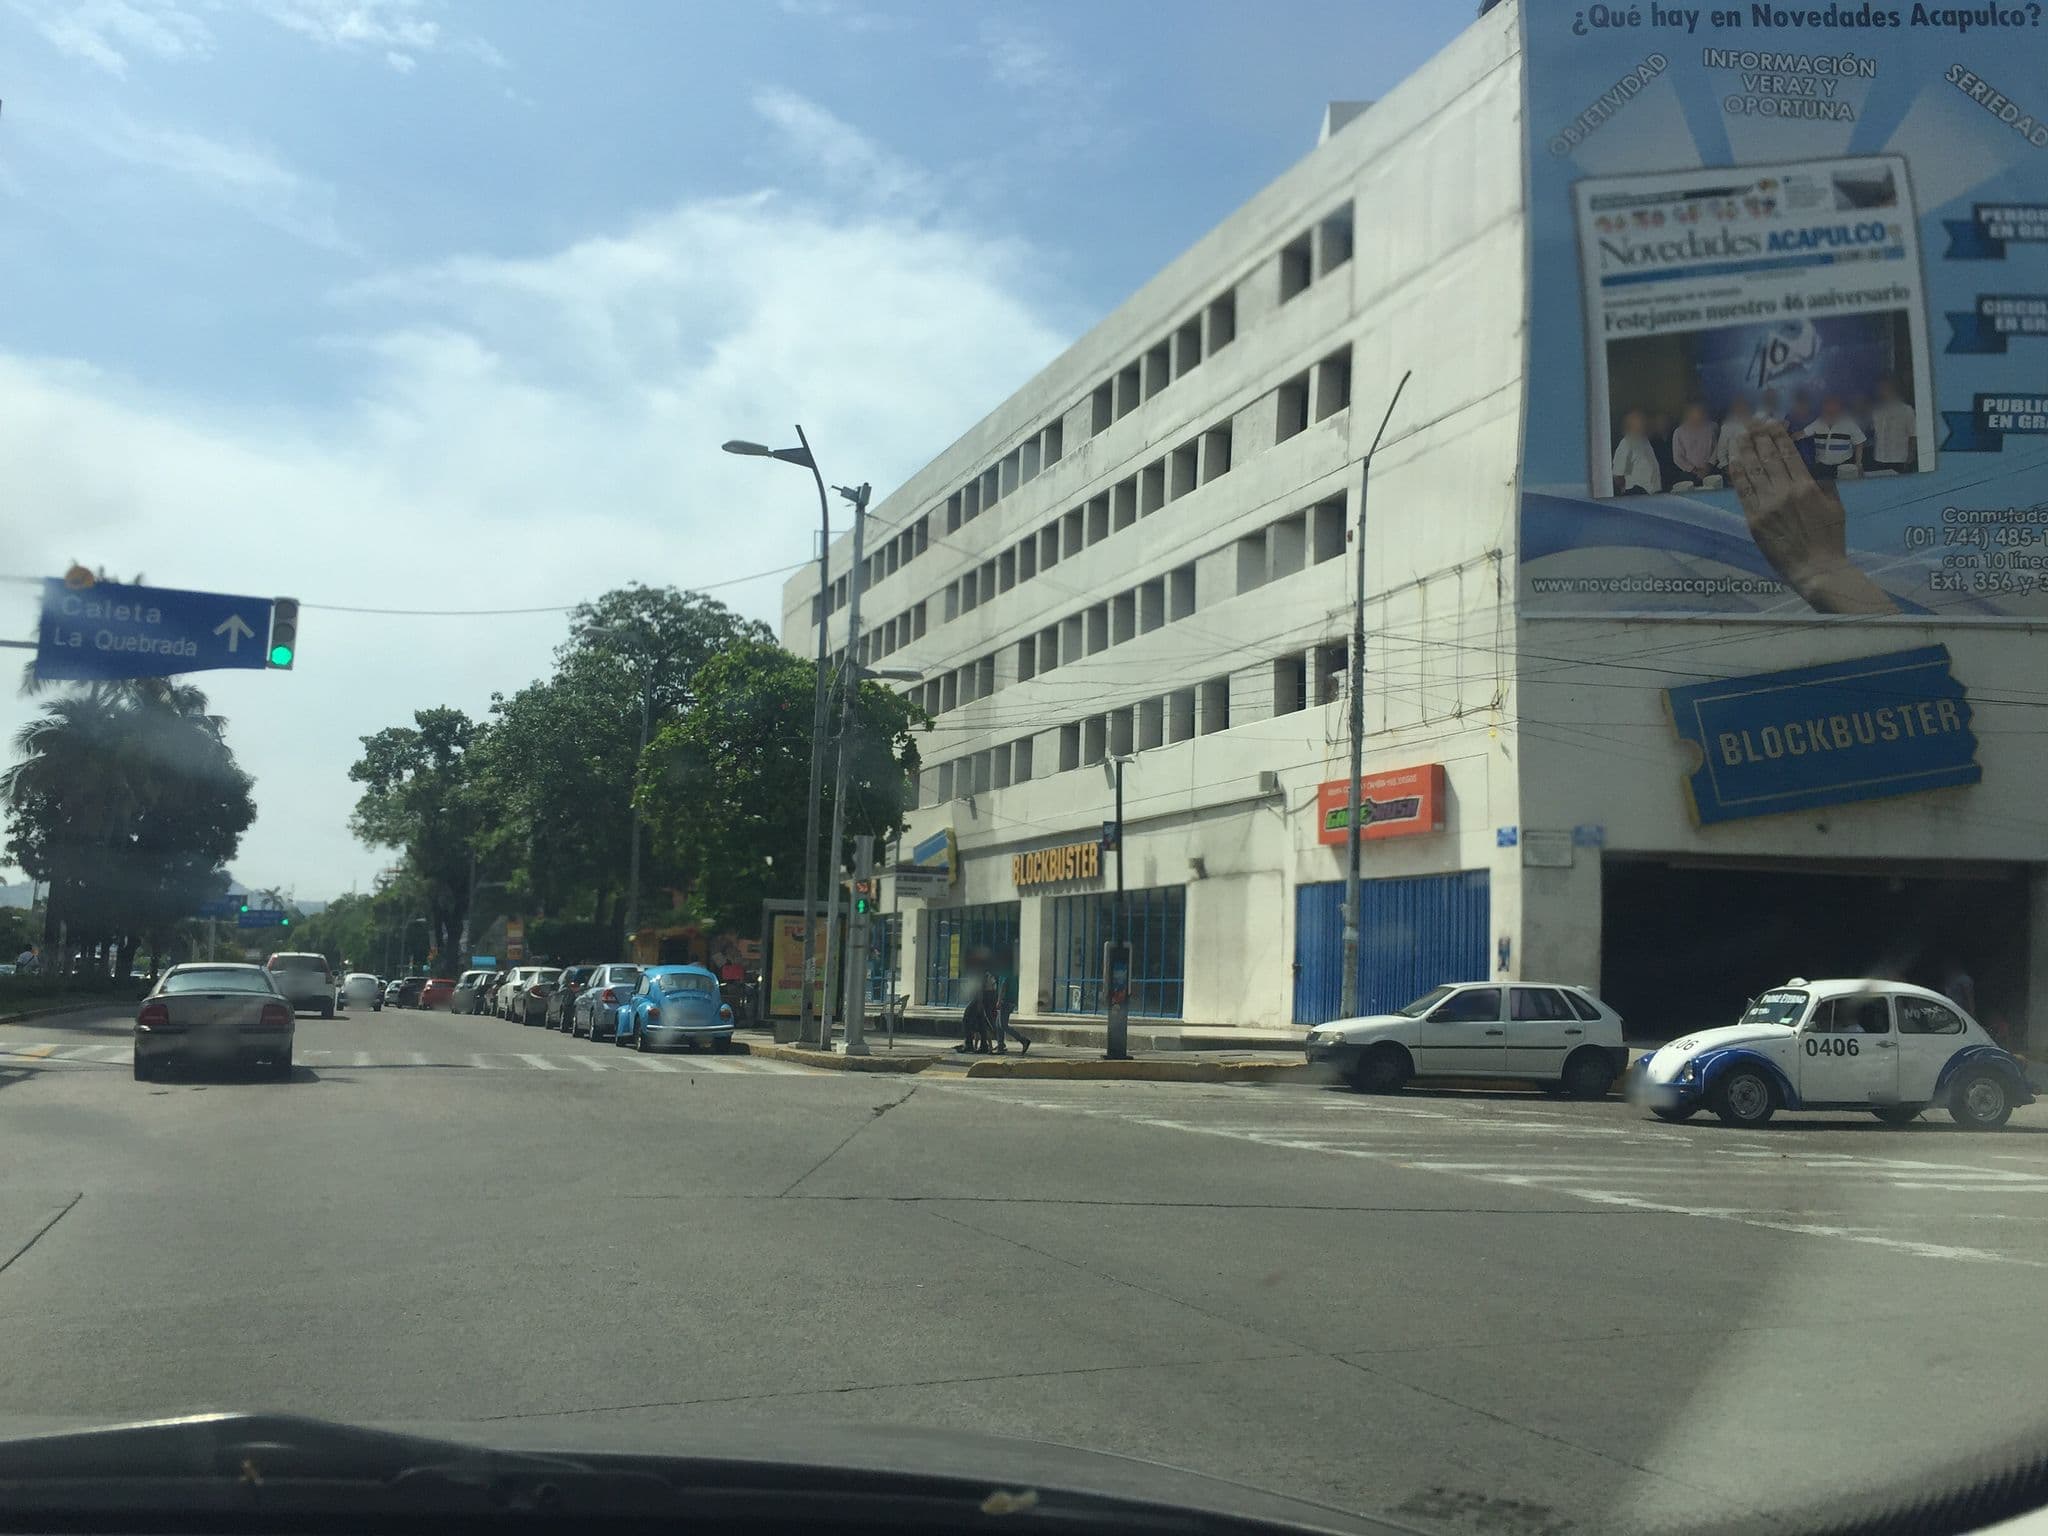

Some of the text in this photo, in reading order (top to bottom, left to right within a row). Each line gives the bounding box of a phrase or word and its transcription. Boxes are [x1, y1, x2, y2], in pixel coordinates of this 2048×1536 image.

[1572, 0, 2042, 36] ¿Qué hay en Novedades Acapulco?
[1703, 48, 1876, 77] INFORMACIÓN
[1742, 73, 1838, 97] VERAZ Y
[1549, 52, 1669, 157] OBJETIVIDAD
[1724, 95, 1855, 121] OPORTUNA
[1944, 63, 2048, 148] SERIEDAD
[1599, 220, 1886, 269] Novedades ACAPULCO
[1808, 281, 1911, 307] aniversario
[1988, 414, 2013, 428] EN
[1904, 526, 1936, 551] (01
[1943, 526, 1990, 551] 744)
[1943, 554, 1980, 569] con
[1983, 551, 2006, 569] 10
[1533, 577, 1784, 597] www.novedadesacapulco.mx
[1929, 570, 1969, 591] Ext.
[1974, 571, 2013, 592] 356
[2019, 575, 2035, 597] y
[60, 595, 162, 624] Caleta
[54, 627, 198, 656] La Quebrada
[1719, 699, 1961, 766] BLOCKBUSTER
[1012, 841, 1099, 888] BLOCKBUSTER
[1805, 1038, 1860, 1057] 0406
